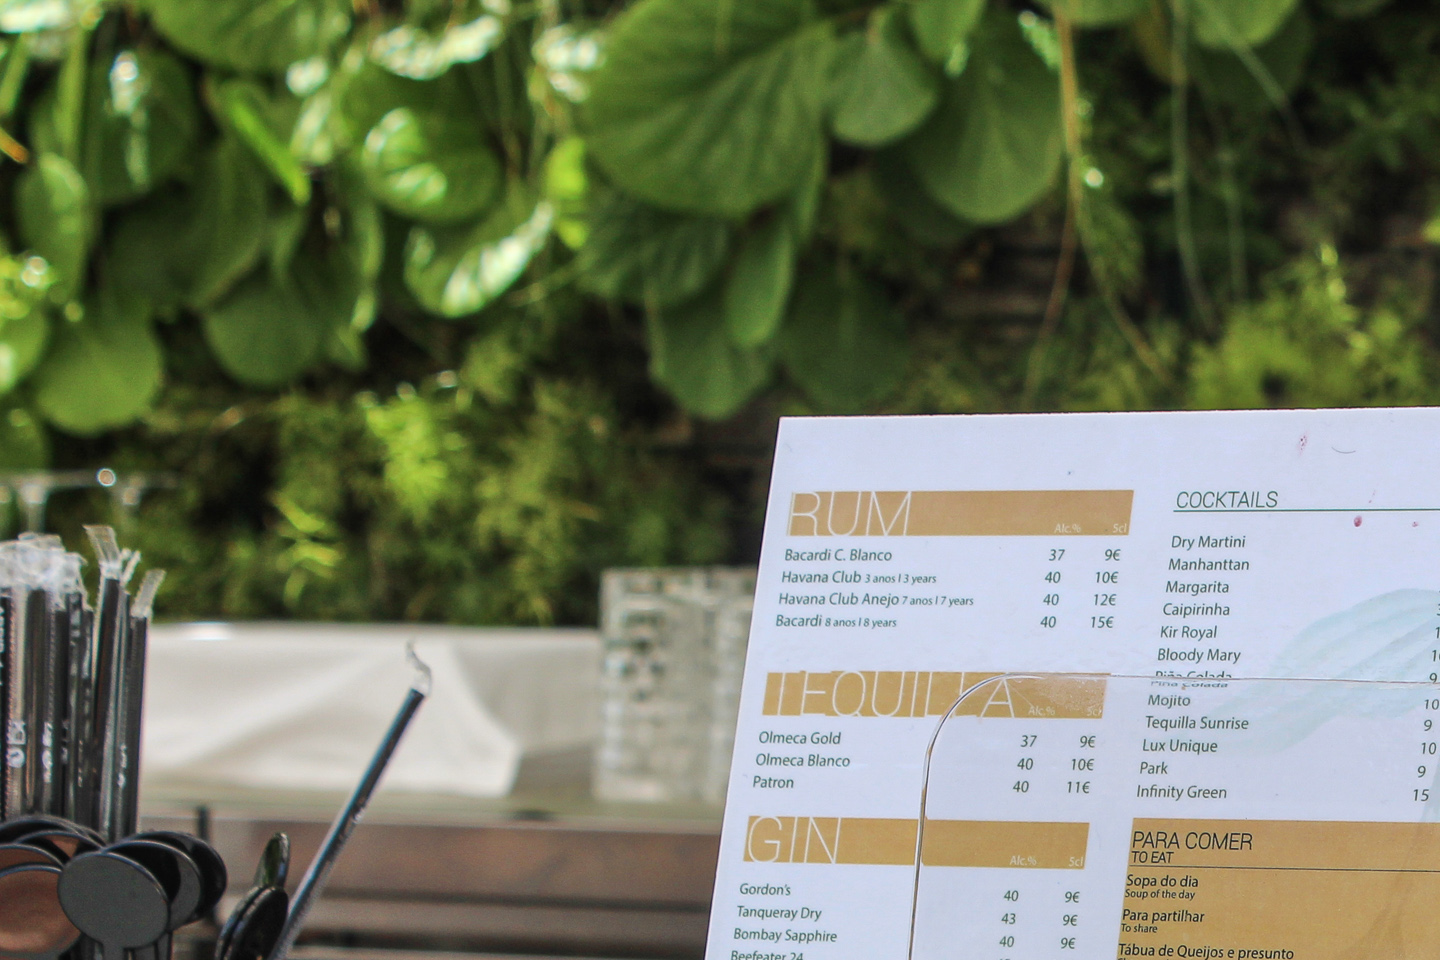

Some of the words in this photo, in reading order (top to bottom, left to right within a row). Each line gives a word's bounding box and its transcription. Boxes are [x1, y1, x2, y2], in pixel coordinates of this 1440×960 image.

[1177, 491, 1278, 508] COCKTAILS
[786, 491, 912, 536] RUM
[1172, 536, 1194, 551] Dry
[1198, 536, 1245, 548] Martini
[785, 549, 831, 561] Bacardi
[834, 549, 845, 561] C.
[850, 549, 892, 561] Blanco
[1049, 549, 1065, 561] 37
[1105, 549, 1120, 561] 9€
[1169, 558, 1249, 570] Manhanttan
[782, 571, 828, 583] Havana
[832, 571, 861, 583] Club
[1045, 572, 1060, 583] 40
[1096, 572, 1118, 583] 10€
[1166, 581, 1229, 596] Margarita
[779, 593, 825, 605] Havana
[829, 592, 858, 605] Club
[862, 593, 899, 608] Anejo
[1043, 594, 1059, 606] 40
[1094, 594, 1116, 606] 12€
[1163, 603, 1230, 618] Caipirinha
[776, 614, 822, 626] Bacardi
[1040, 616, 1056, 628] 40
[1092, 616, 1114, 628] 15€
[1161, 626, 1178, 638] Kir
[1182, 626, 1217, 641] Royal
[1158, 648, 1204, 664] Bloody
[1207, 649, 1241, 664] Mary
[1148, 695, 1190, 709] Mojito
[1146, 716, 1196, 731] Tequilla
[1200, 716, 1248, 729] Sunrise
[759, 731, 806, 744] Olmeca
[811, 732, 841, 744] Gold
[1021, 735, 1037, 747] 37
[1080, 736, 1096, 748] 9€
[1143, 739, 1166, 751] Lux
[1170, 739, 1218, 755] Unique
[756, 753, 804, 766] Olmeca
[808, 754, 850, 767] Blanco
[1017, 758, 1033, 770] 40
[1072, 759, 1094, 770] 10€
[1140, 762, 1167, 774] Park
[753, 776, 794, 788] Patron
[1013, 781, 1029, 792] 40
[1068, 782, 1090, 794] 11€
[1137, 784, 1184, 801] Infinity
[1187, 786, 1226, 798] Green
[747, 816, 841, 864] GIN
[1010, 855, 1036, 866] Alc.%
[1133, 831, 1180, 848] PARA
[1186, 832, 1252, 850] COMER
[1132, 851, 1148, 863] TO
[1151, 851, 1174, 863] EAT
[1126, 874, 1156, 889] Sopa
[1160, 875, 1176, 887] do
[1180, 875, 1198, 887] dia
[740, 883, 790, 896] Gordon's
[1125, 888, 1148, 900] Soup
[1150, 889, 1160, 898] of
[1162, 889, 1176, 898] the
[1178, 890, 1195, 901] day
[738, 906, 798, 921] Tanqueray
[801, 907, 822, 922] Dry
[1123, 909, 1148, 921] Para
[1152, 910, 1204, 924] partilhar
[1121, 923, 1131, 932] To
[1134, 924, 1157, 933] share
[734, 928, 782, 943] Bombay
[785, 929, 837, 944] Sapphire
[1119, 944, 1154, 956] Tábua
[1158, 944, 1174, 956] de
[1177, 945, 1223, 960] Queijos
[1228, 950, 1234, 958] e
